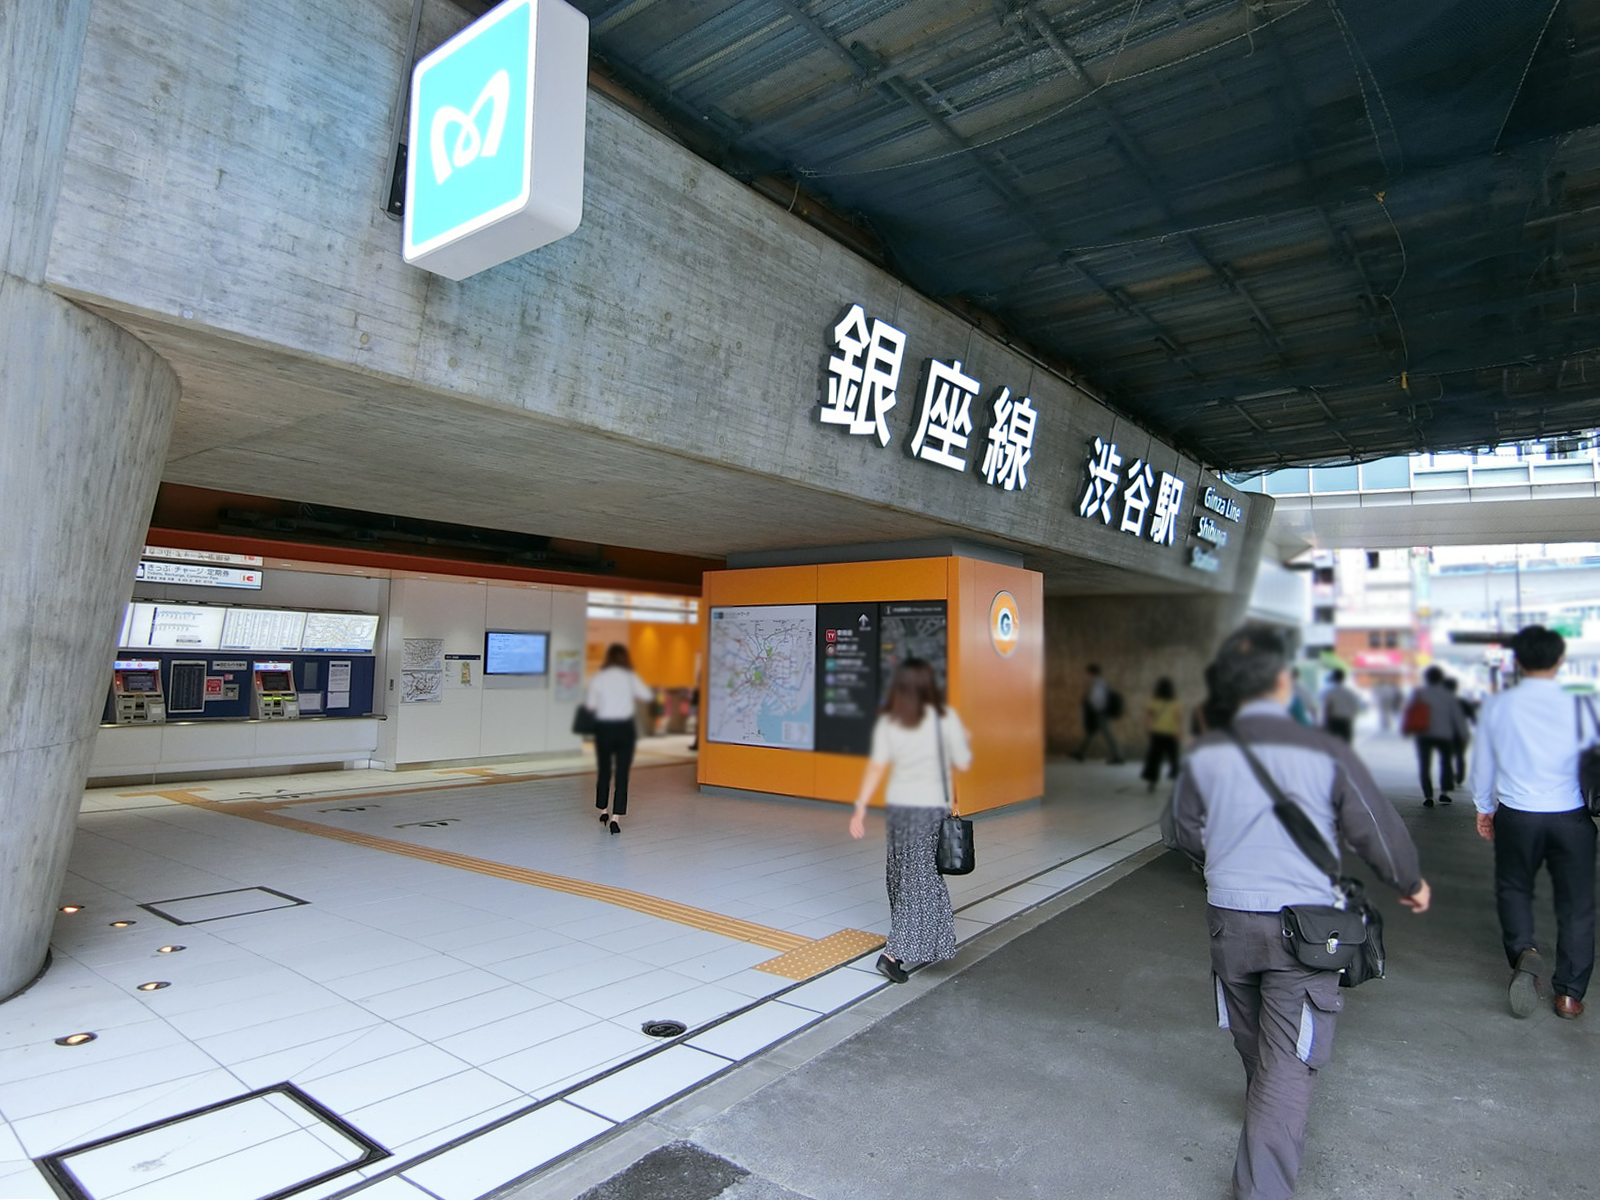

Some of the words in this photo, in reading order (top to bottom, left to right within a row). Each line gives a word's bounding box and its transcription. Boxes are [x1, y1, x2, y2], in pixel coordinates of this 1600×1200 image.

[819, 303, 1039, 491] 銀座線
[1078, 436, 1186, 547] 渋谷駅
[1204, 486, 1226, 515] Ginza
[1225, 498, 1242, 523] Line
[1197, 516, 1227, 547] Shibuya
[1000, 612, 1011, 637] G
